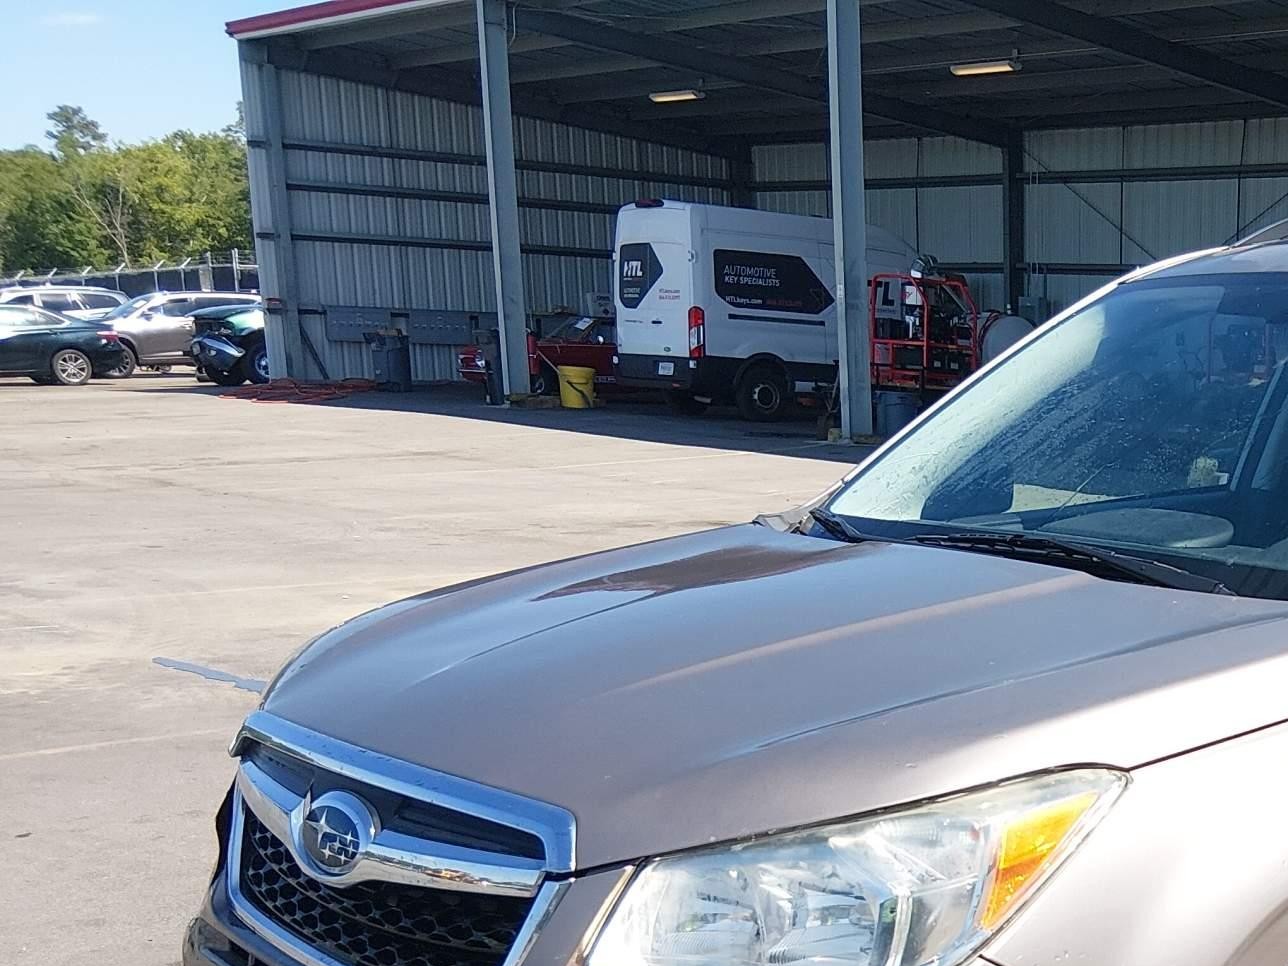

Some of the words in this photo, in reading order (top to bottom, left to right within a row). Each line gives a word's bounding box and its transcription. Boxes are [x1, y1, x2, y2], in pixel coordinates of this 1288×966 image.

[624, 261, 643, 277] HTL
[723, 265, 777, 279] AUTOMOTIVE
[724, 275, 739, 284] KEY
[739, 276, 781, 287] SPECIALISTS
